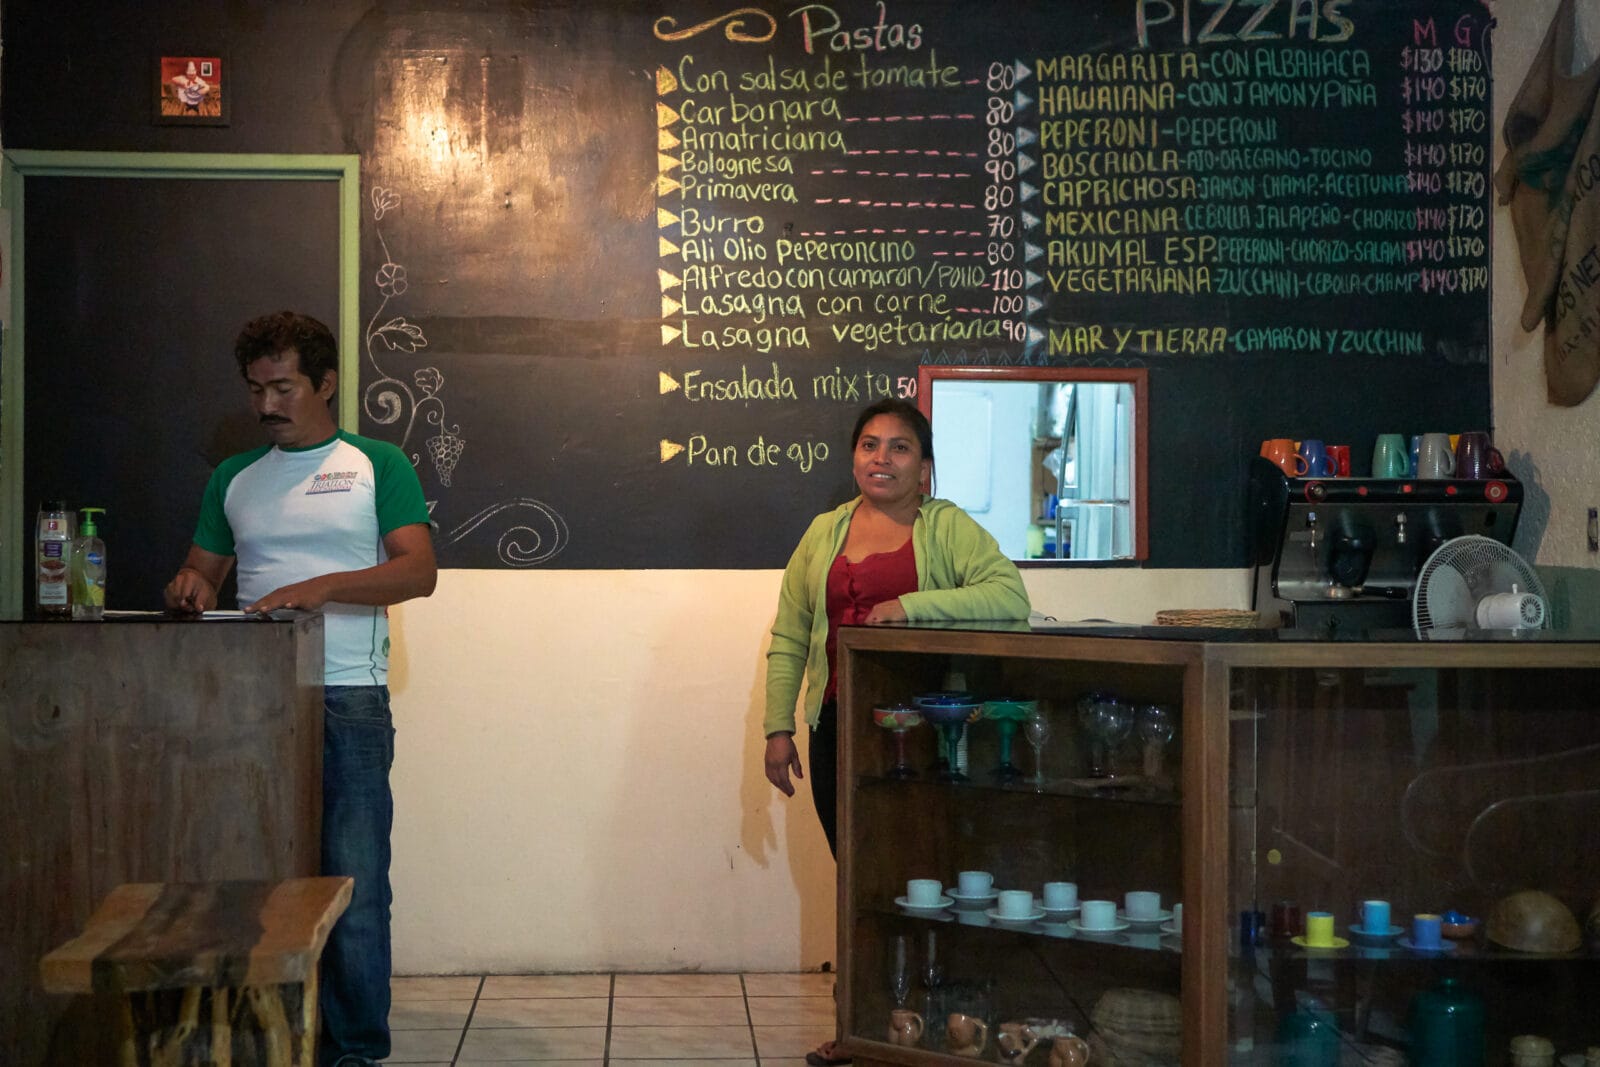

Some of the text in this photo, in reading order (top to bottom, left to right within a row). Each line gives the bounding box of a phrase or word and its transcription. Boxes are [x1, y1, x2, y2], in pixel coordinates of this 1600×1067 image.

[788, 1, 923, 54] Pastas
[1136, 0, 1355, 48] PIZZAS
[1413, 14, 1471, 47] M G
[678, 48, 1014, 93] Con salsa de tomate 80
[1255, 48, 1370, 78] ALBAHACA
[1400, 46, 1444, 74] $130
[1232, 81, 1306, 106] JAMON
[1402, 76, 1446, 105] $140
[1450, 75, 1486, 101] $170
[680, 96, 1014, 126] Carbonara 80
[1402, 108, 1444, 134] $140
[1449, 107, 1485, 134] $170
[681, 126, 1015, 157] Amatriciana 80
[1404, 140, 1446, 167] $140
[1449, 142, 1485, 167] $170
[681, 153, 1015, 184] Bolognesa 90
[1445, 170, 1485, 199] $170
[681, 174, 1014, 211] Primavera 80
[681, 208, 1014, 239] Burro 70
[1447, 203, 1484, 235] $170
[681, 238, 714, 262] Ali
[723, 237, 767, 260] Olio
[987, 241, 1014, 265] 80
[1047, 238, 1156, 267] AKUMAL
[1447, 235, 1485, 259] $170
[991, 269, 1023, 292] 110
[682, 292, 1023, 324] Lasagna con carne 100
[682, 315, 1027, 353] Lasagna vegetariana 90
[1049, 324, 1109, 355] MAR
[1113, 328, 1132, 354] Y
[1327, 329, 1338, 354] Y
[684, 361, 798, 402] Ensalada
[897, 376, 917, 399] 50
[687, 435, 830, 473] Pan de ajo
